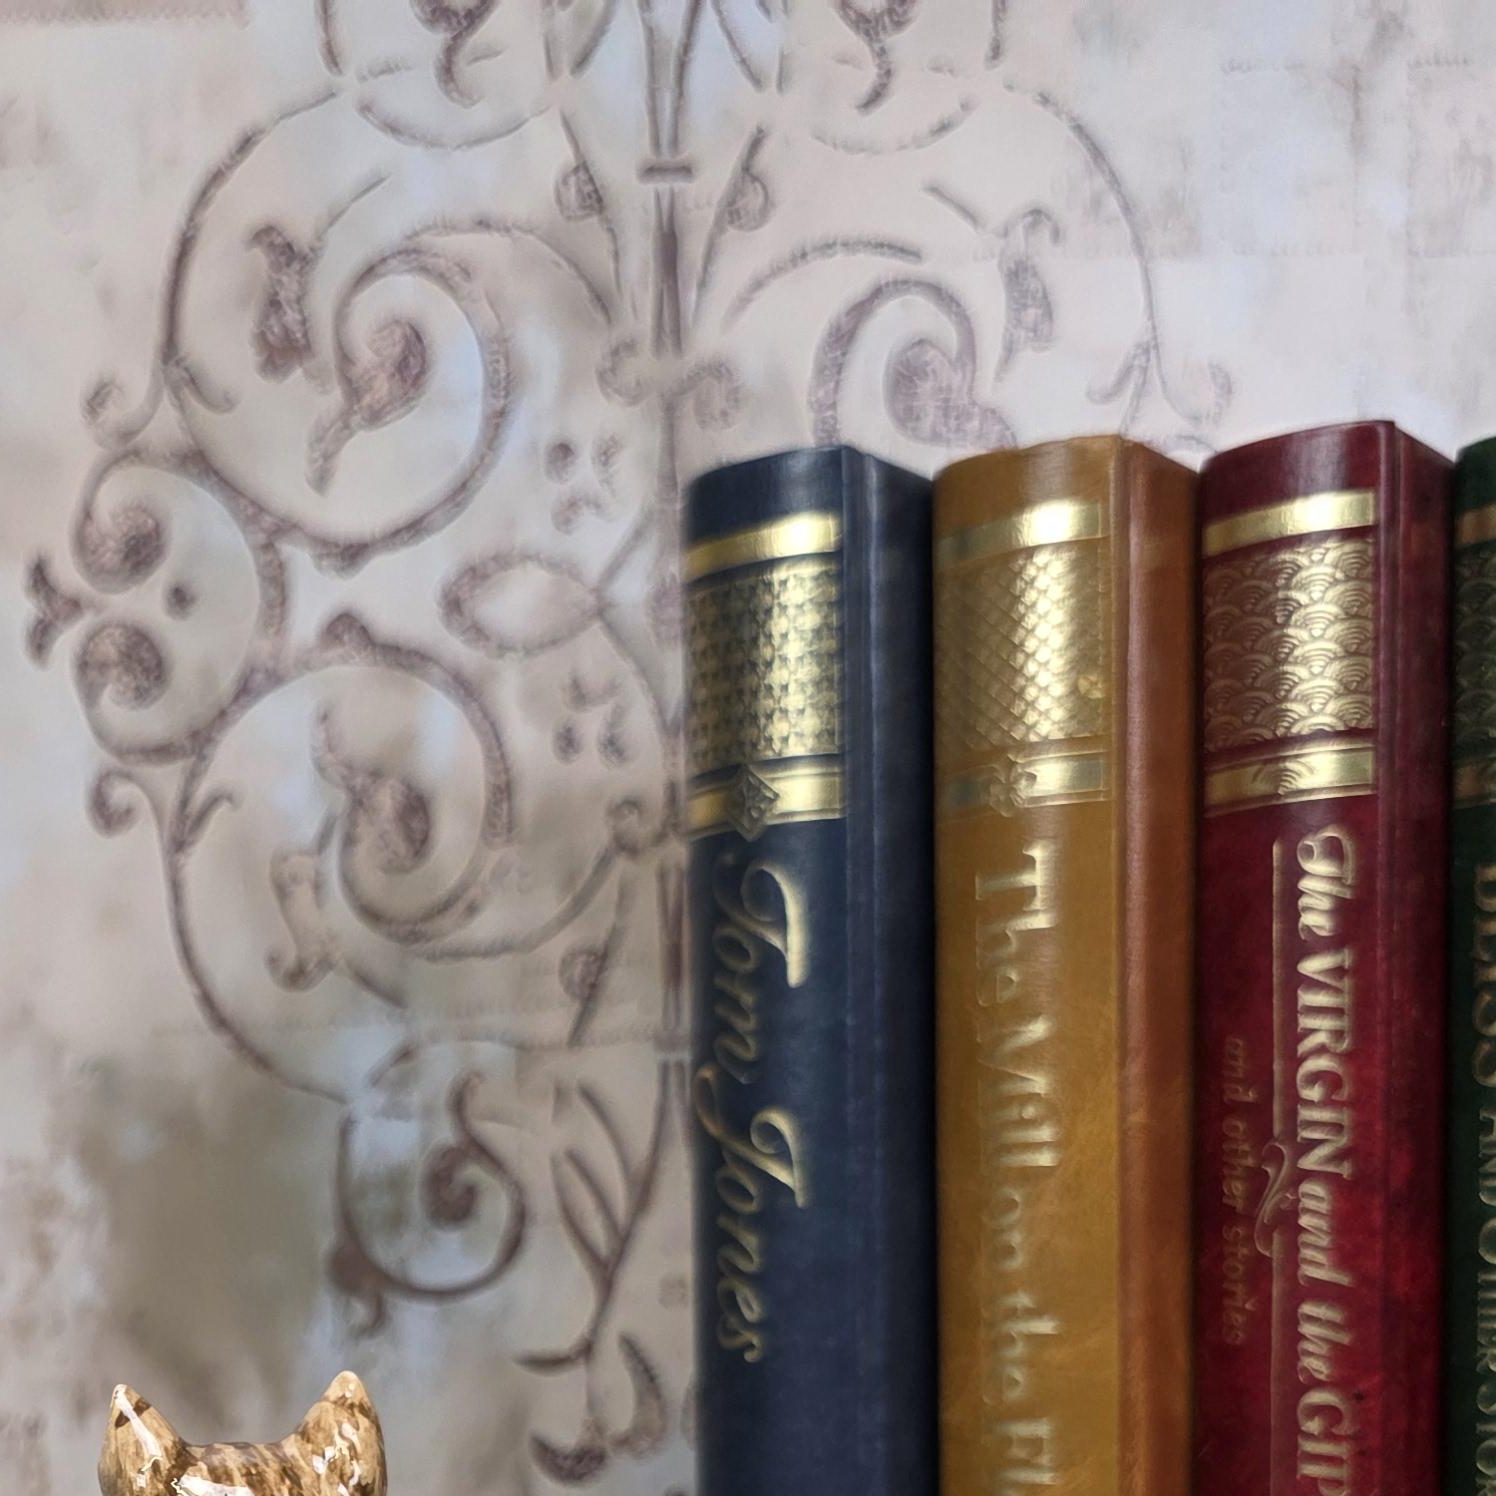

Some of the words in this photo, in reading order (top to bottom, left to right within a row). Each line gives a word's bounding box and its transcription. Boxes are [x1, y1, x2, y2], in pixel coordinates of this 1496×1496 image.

[974, 842, 1058, 1008] The
[1294, 825, 1358, 940] The
[711, 849, 812, 1084] Tom
[975, 1014, 1062, 1172] Mill
[1222, 1036, 1260, 1104] and
[1294, 949, 1353, 1180] VIRGIN
[693, 1060, 814, 1363] Jones
[1221, 1117, 1259, 1213] other
[1296, 1180, 1349, 1285] and
[1297, 1300, 1349, 1384] the
